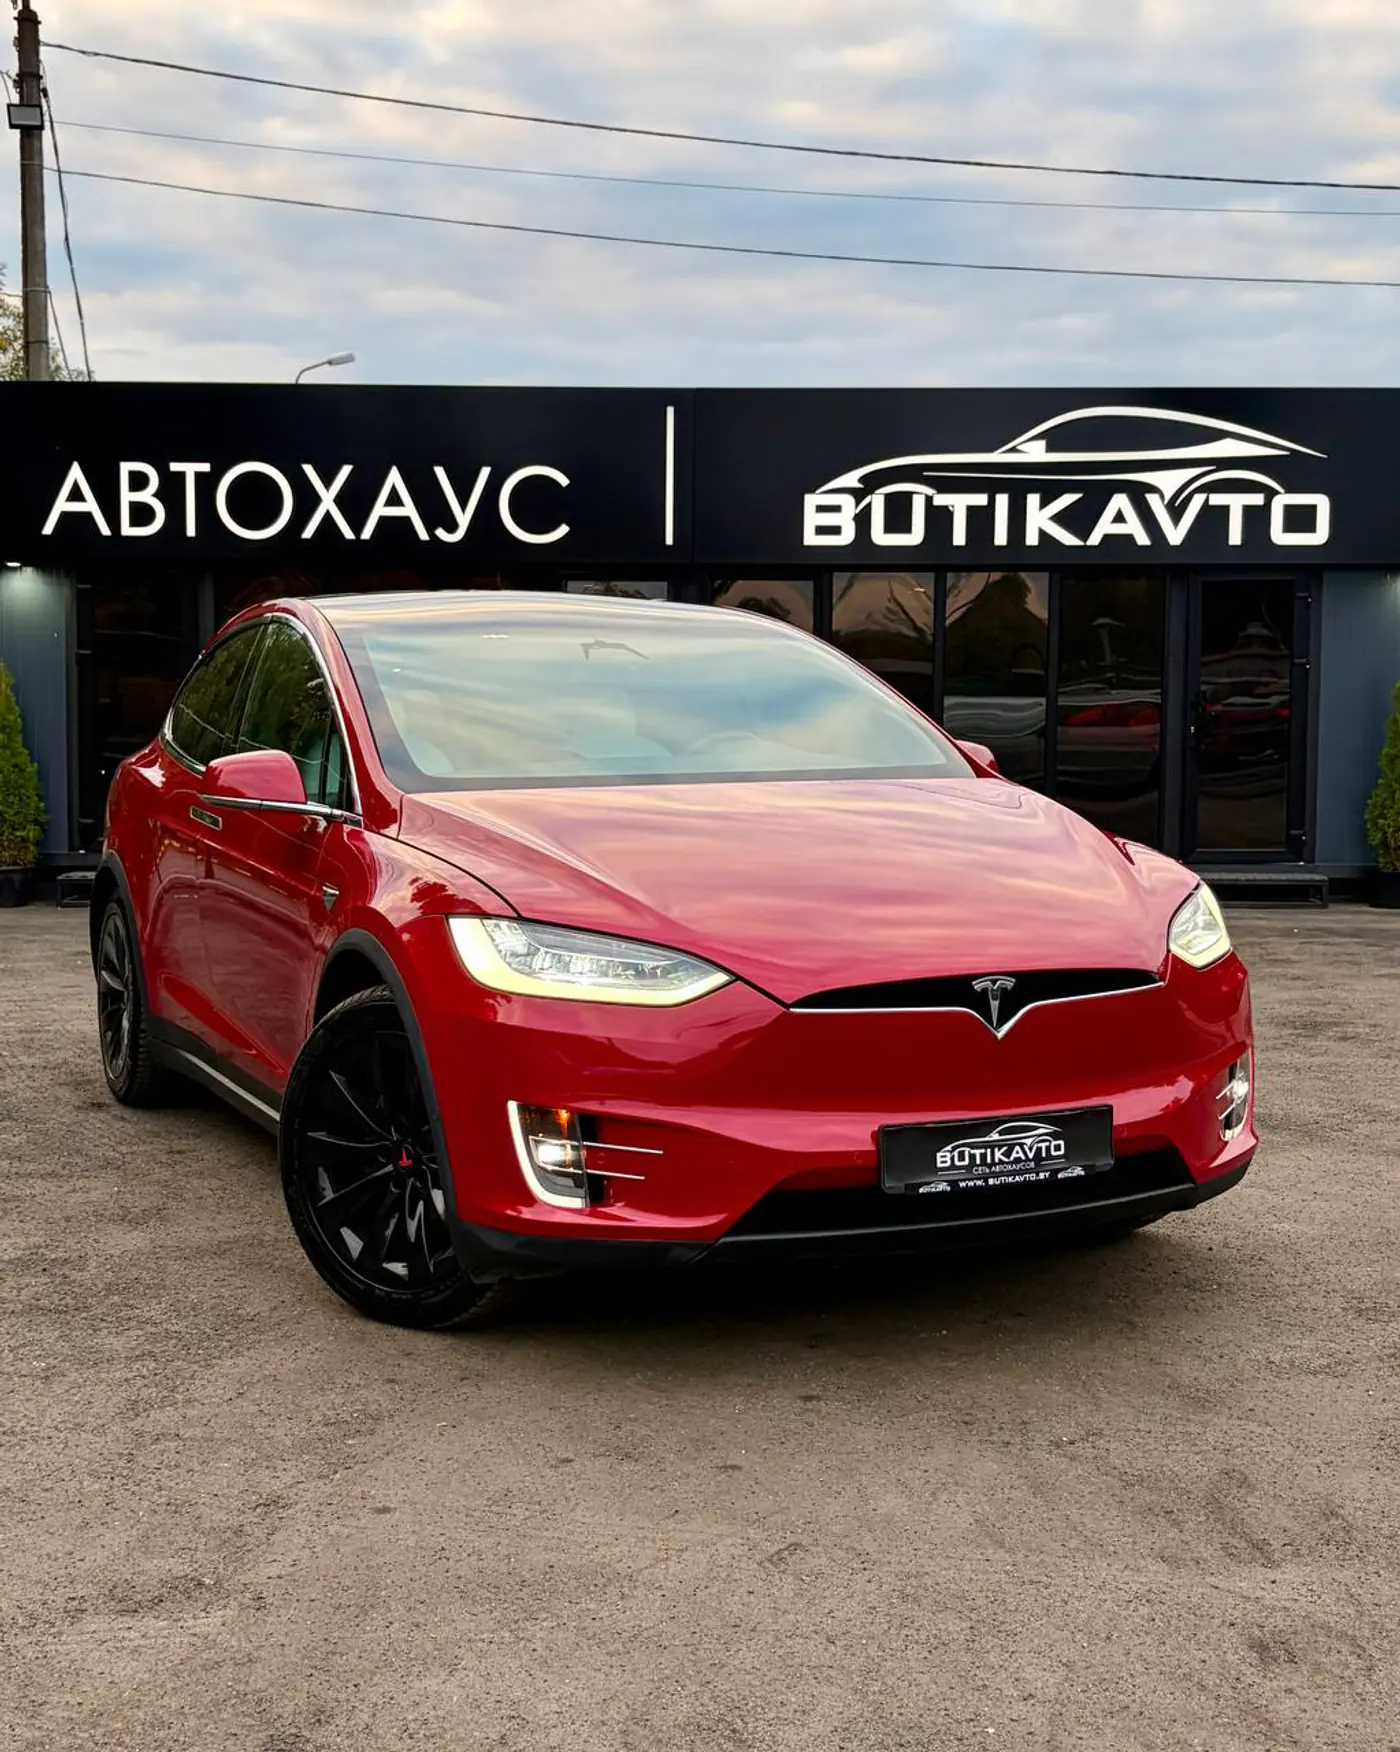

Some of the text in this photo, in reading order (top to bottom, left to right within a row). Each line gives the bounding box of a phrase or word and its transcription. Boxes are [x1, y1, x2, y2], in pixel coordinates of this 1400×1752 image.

[41, 460, 571, 543] АВТОХАУС
[803, 493, 1331, 546] BUTIKAVTO
[936, 1140, 1065, 1168] BUTIKAVTO
